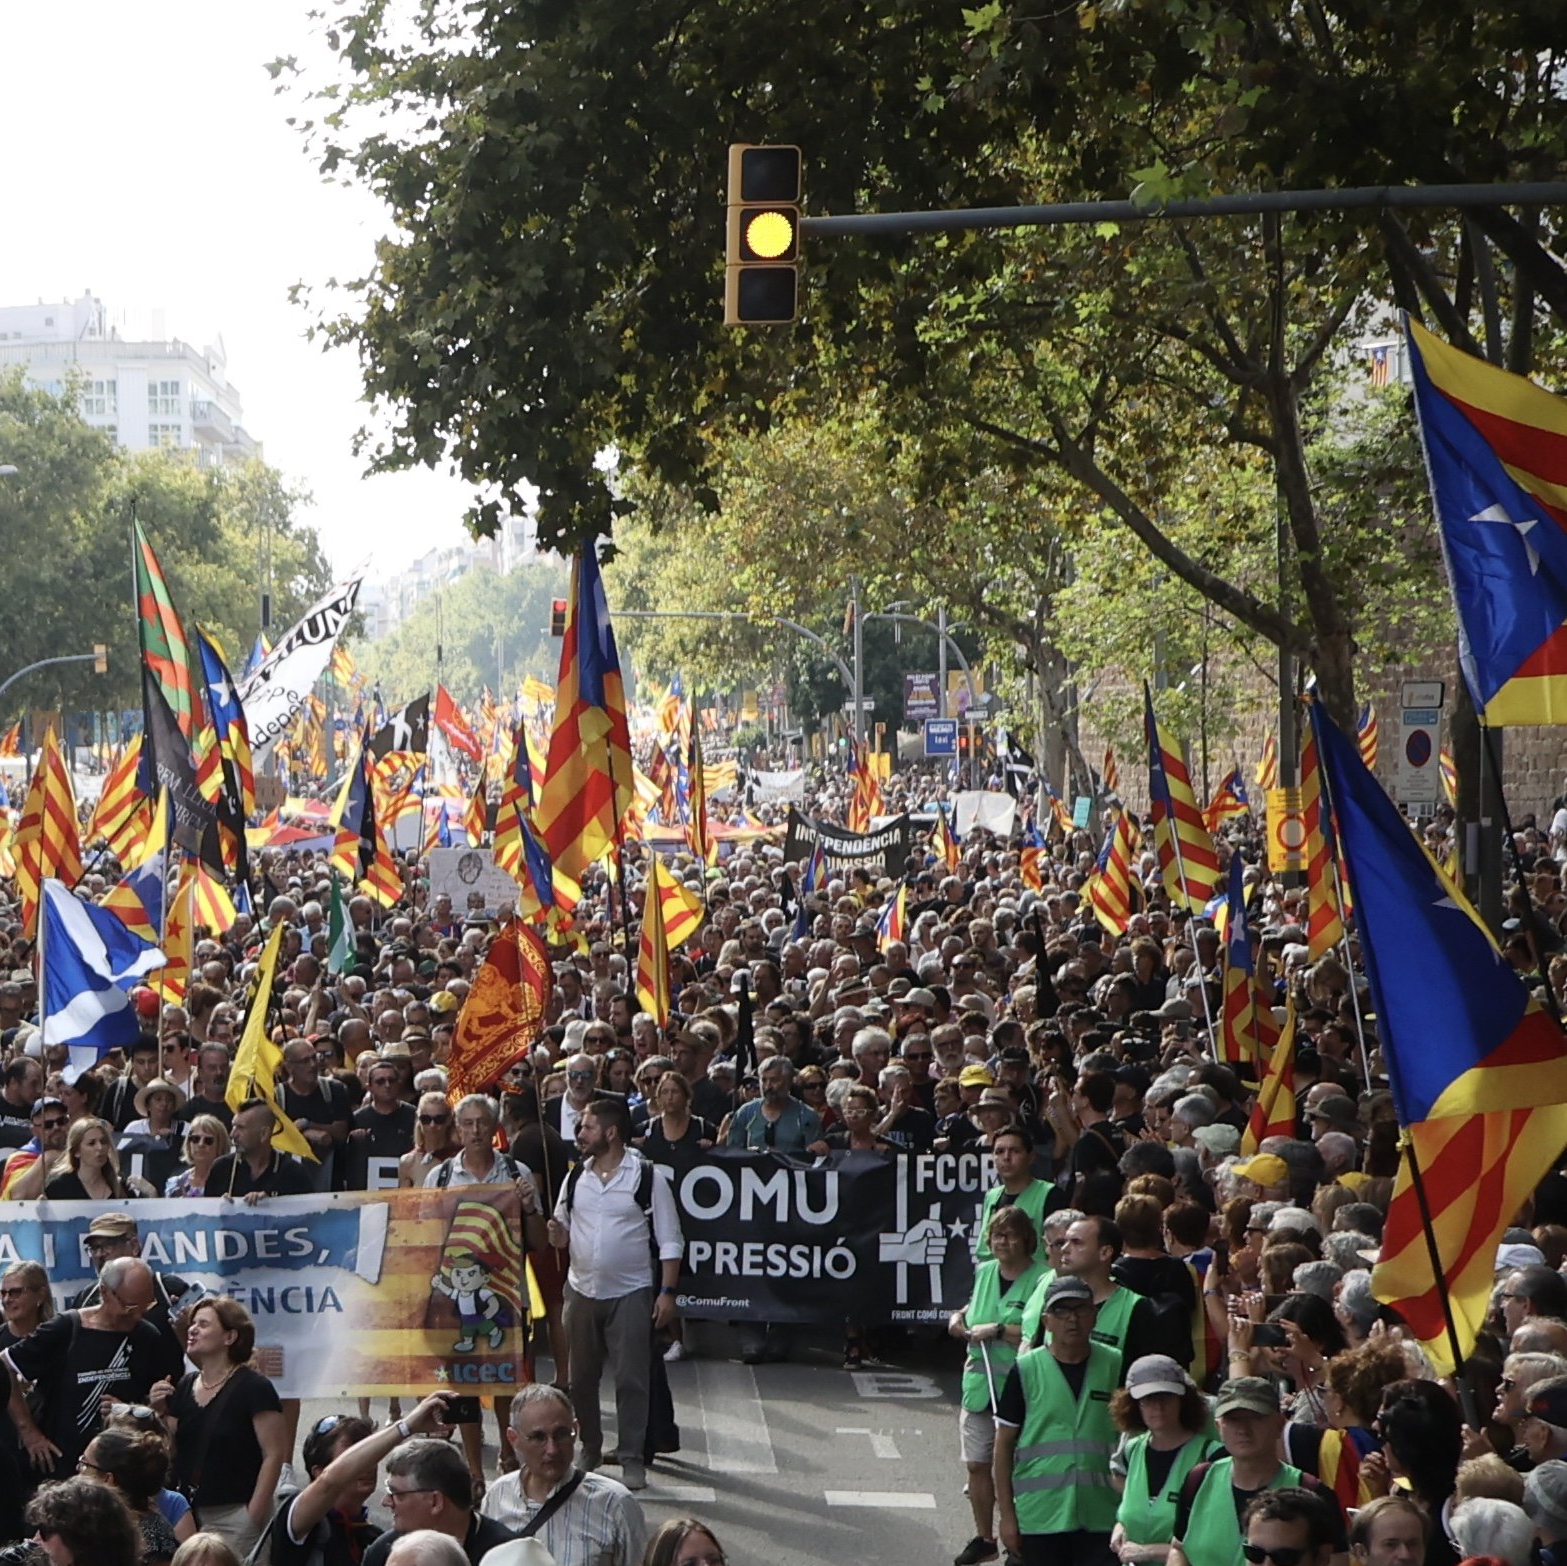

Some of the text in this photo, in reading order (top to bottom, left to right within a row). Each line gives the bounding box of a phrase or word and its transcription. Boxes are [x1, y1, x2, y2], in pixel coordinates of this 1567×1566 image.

[43, 1233, 55, 1268] I
[689, 1236, 858, 1280] PRESSIÓ
[675, 1294, 750, 1309] @ComuFront
[891, 1310, 915, 1321] FRONT
